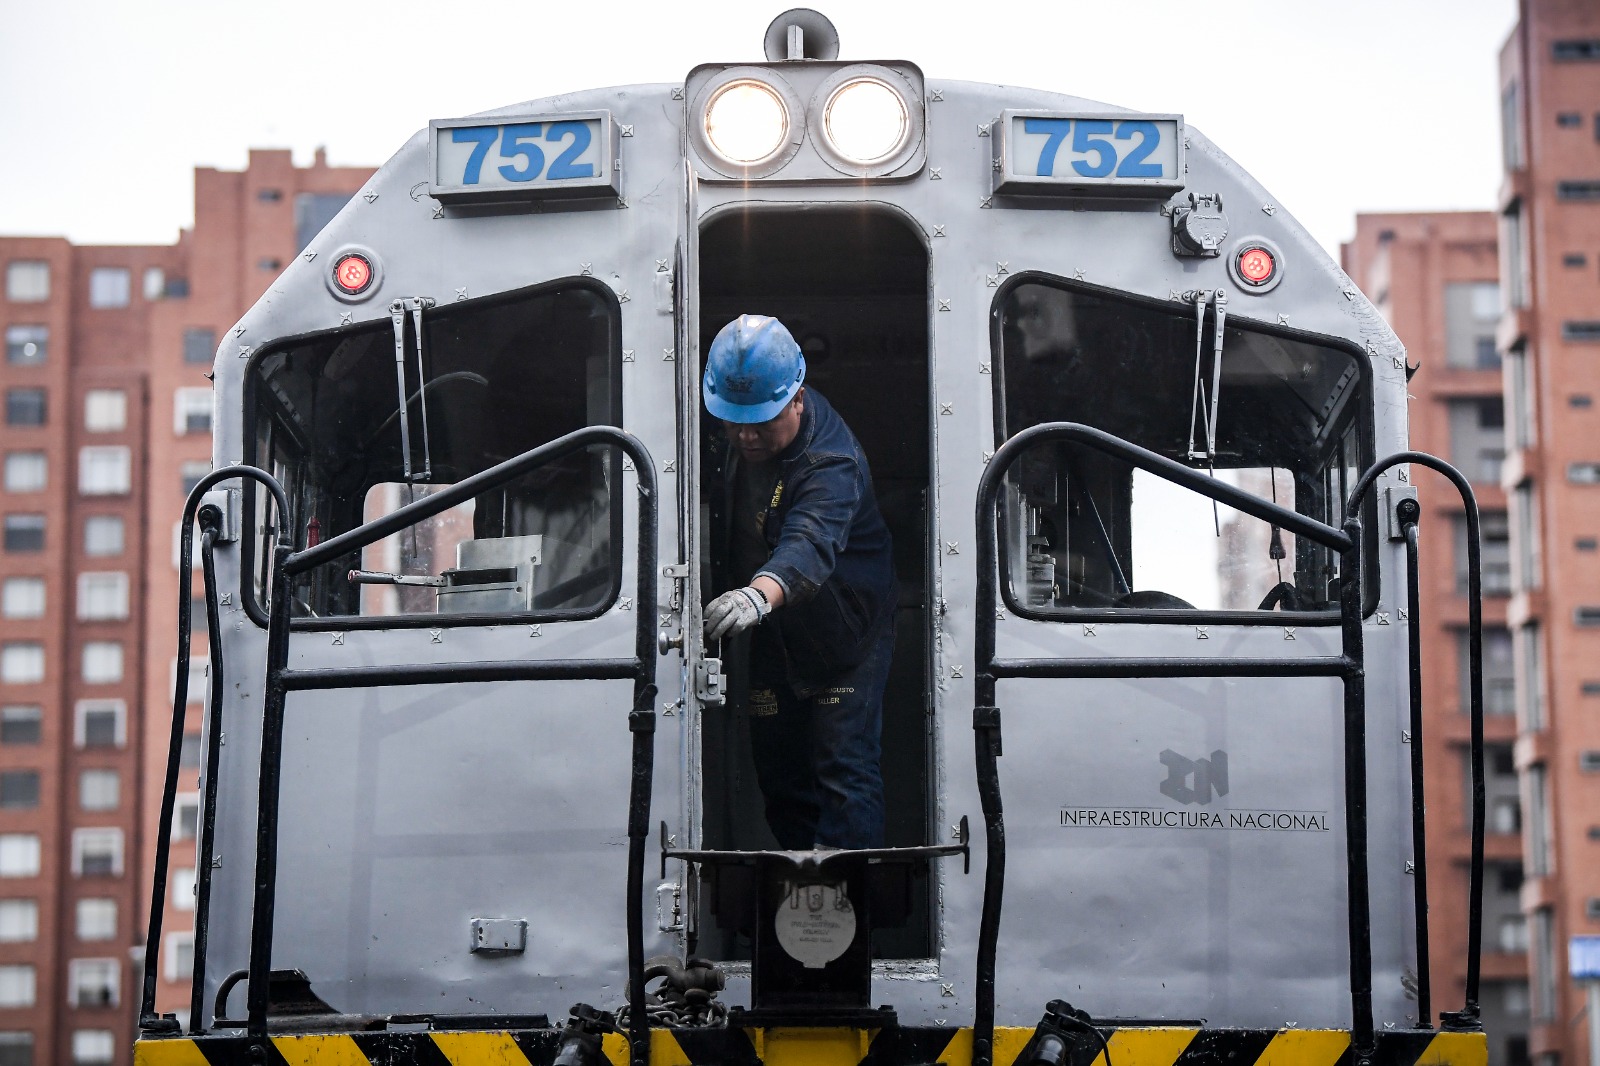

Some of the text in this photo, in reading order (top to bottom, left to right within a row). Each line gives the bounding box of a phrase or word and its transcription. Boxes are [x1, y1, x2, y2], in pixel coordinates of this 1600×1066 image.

[451, 121, 593, 185] 752
[1024, 119, 1163, 178] 752
[1059, 809, 1331, 831] INFRAESTRUCTURA NACIONAL
